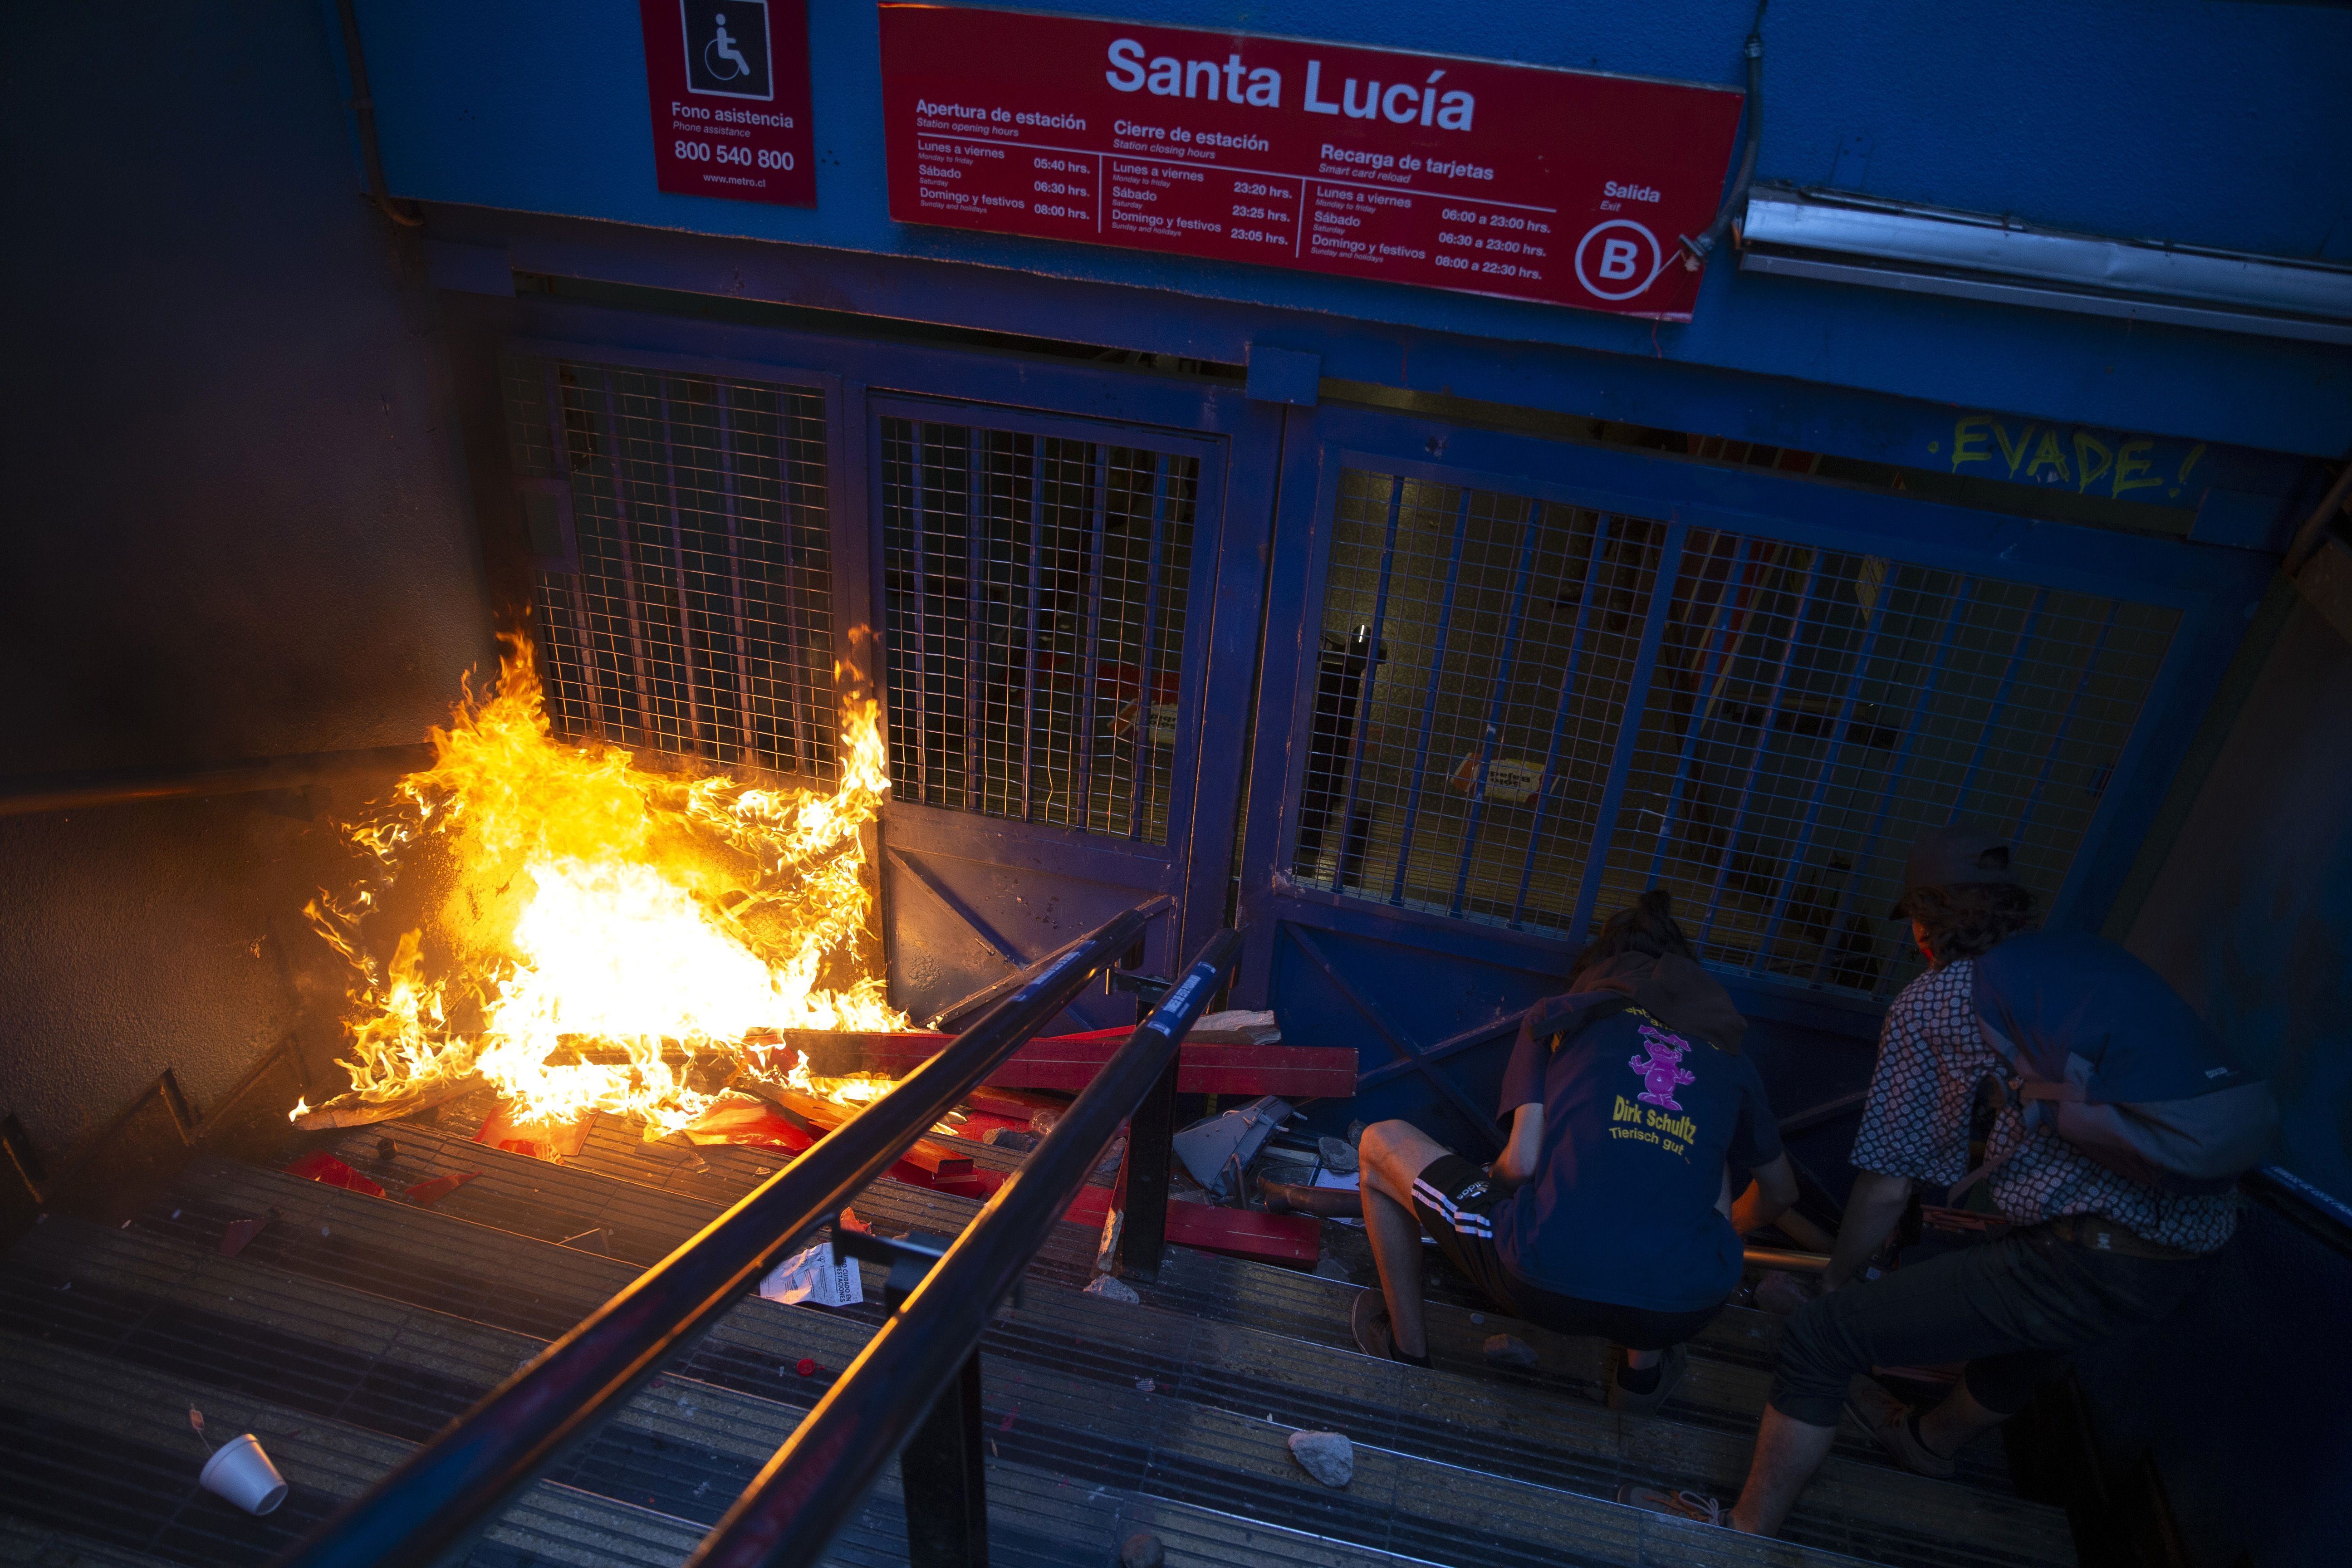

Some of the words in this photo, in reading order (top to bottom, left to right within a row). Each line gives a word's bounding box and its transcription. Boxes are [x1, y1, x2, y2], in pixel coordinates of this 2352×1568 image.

[1105, 38, 1282, 108] Santa
[1303, 59, 1476, 132] Lucía
[671, 101, 710, 120] Fono
[715, 108, 794, 129] asistencia
[916, 99, 986, 120] Apertura
[991, 107, 1011, 122] de
[1016, 112, 1086, 131] estación
[673, 121, 701, 132] Phone
[703, 126, 751, 137] assistance
[917, 117, 950, 129] Station
[952, 123, 990, 136] opening
[992, 126, 1019, 137] hours
[1114, 119, 1165, 139] Cierre
[1170, 127, 1191, 142] de
[1196, 132, 1269, 152] estación
[675, 140, 711, 162] 800
[716, 145, 752, 166] 540
[758, 149, 794, 171] 800
[918, 139, 951, 153] Lunes
[955, 146, 961, 154] a
[964, 145, 1004, 159] viernes
[1113, 138, 1147, 151] Station
[1150, 144, 1185, 157] closing
[1187, 147, 1215, 159] hours
[918, 152, 944, 162] Monday
[955, 157, 973, 166] friday
[1034, 157, 1065, 171] 05:40
[1068, 162, 1090, 174] hrs.
[1321, 143, 1394, 169] Recarga
[1399, 154, 1421, 171] de
[1426, 158, 1493, 180] tarjetas
[703, 174, 766, 188] www.metro.cl
[919, 164, 961, 179] Sábado
[1112, 174, 1141, 185] Monday
[1151, 178, 1171, 188] friday
[1113, 161, 1148, 176] Lunes
[1152, 167, 1158, 176] a
[1162, 167, 1204, 182] viernes
[1319, 162, 1350, 176] Smart
[1352, 169, 1376, 179] card
[1377, 172, 1411, 184] reload
[919, 177, 948, 187] Saturday
[1034, 181, 1065, 194] 06:30
[1068, 185, 1089, 197] hrs.
[1234, 181, 1267, 196] 23:20
[1269, 186, 1292, 199] hrs.
[1603, 180, 1661, 203] Salida
[921, 187, 970, 204] Domingo
[972, 196, 979, 206] y
[982, 194, 1024, 209] festivos
[1113, 186, 1157, 201] Sábado
[1317, 185, 1353, 201] Lunes
[1357, 193, 1364, 202] a
[1367, 193, 1411, 208] viernes
[921, 199, 944, 209] Sunday
[960, 204, 987, 214] holidays
[1034, 203, 1065, 217] 08:00
[1068, 207, 1089, 220] hrs.
[1112, 199, 1142, 210] Saturday
[1232, 205, 1264, 219] 23:25
[1268, 209, 1290, 222] hrs.
[1315, 199, 1345, 210] Monday
[1355, 204, 1376, 214] friday
[1600, 200, 1622, 212] Exit
[1112, 209, 1164, 227] Domingo
[1167, 218, 1173, 229] y
[1176, 217, 1221, 233] festivos
[1112, 221, 1137, 232] Sunday
[1153, 227, 1181, 237] holidays
[1313, 223, 1345, 235] Saturday
[1314, 211, 1361, 227] Sábado
[1442, 208, 1476, 223] 06:00
[1479, 216, 1487, 225] a
[1490, 215, 1524, 230] 23:00
[1527, 220, 1550, 234] hrs.
[1231, 228, 1263, 242] 23:05
[1266, 232, 1288, 245] hrs.
[1313, 233, 1366, 253] Domingo
[1368, 244, 1376, 255] y
[1379, 243, 1426, 259] festivos
[1439, 232, 1473, 246] 06:30
[1475, 239, 1483, 248] a
[1486, 238, 1520, 253] 23:00
[1523, 244, 1546, 257] hrs.
[1311, 246, 1337, 258] Sunday
[1353, 251, 1383, 263] holidays
[1598, 238, 1639, 280] B
[1435, 255, 1469, 270] 08:00
[1471, 262, 1480, 271] a
[1482, 261, 1516, 276] 22:30
[1519, 267, 1541, 280] hrs.
[1612, 1094, 1642, 1124] Dirk
[1646, 1109, 1697, 1145] Schultz
[1609, 1127, 1660, 1145] Tierisch
[1662, 1138, 1684, 1156] gut
[836, 1266, 845, 1303] FESTACIONES
